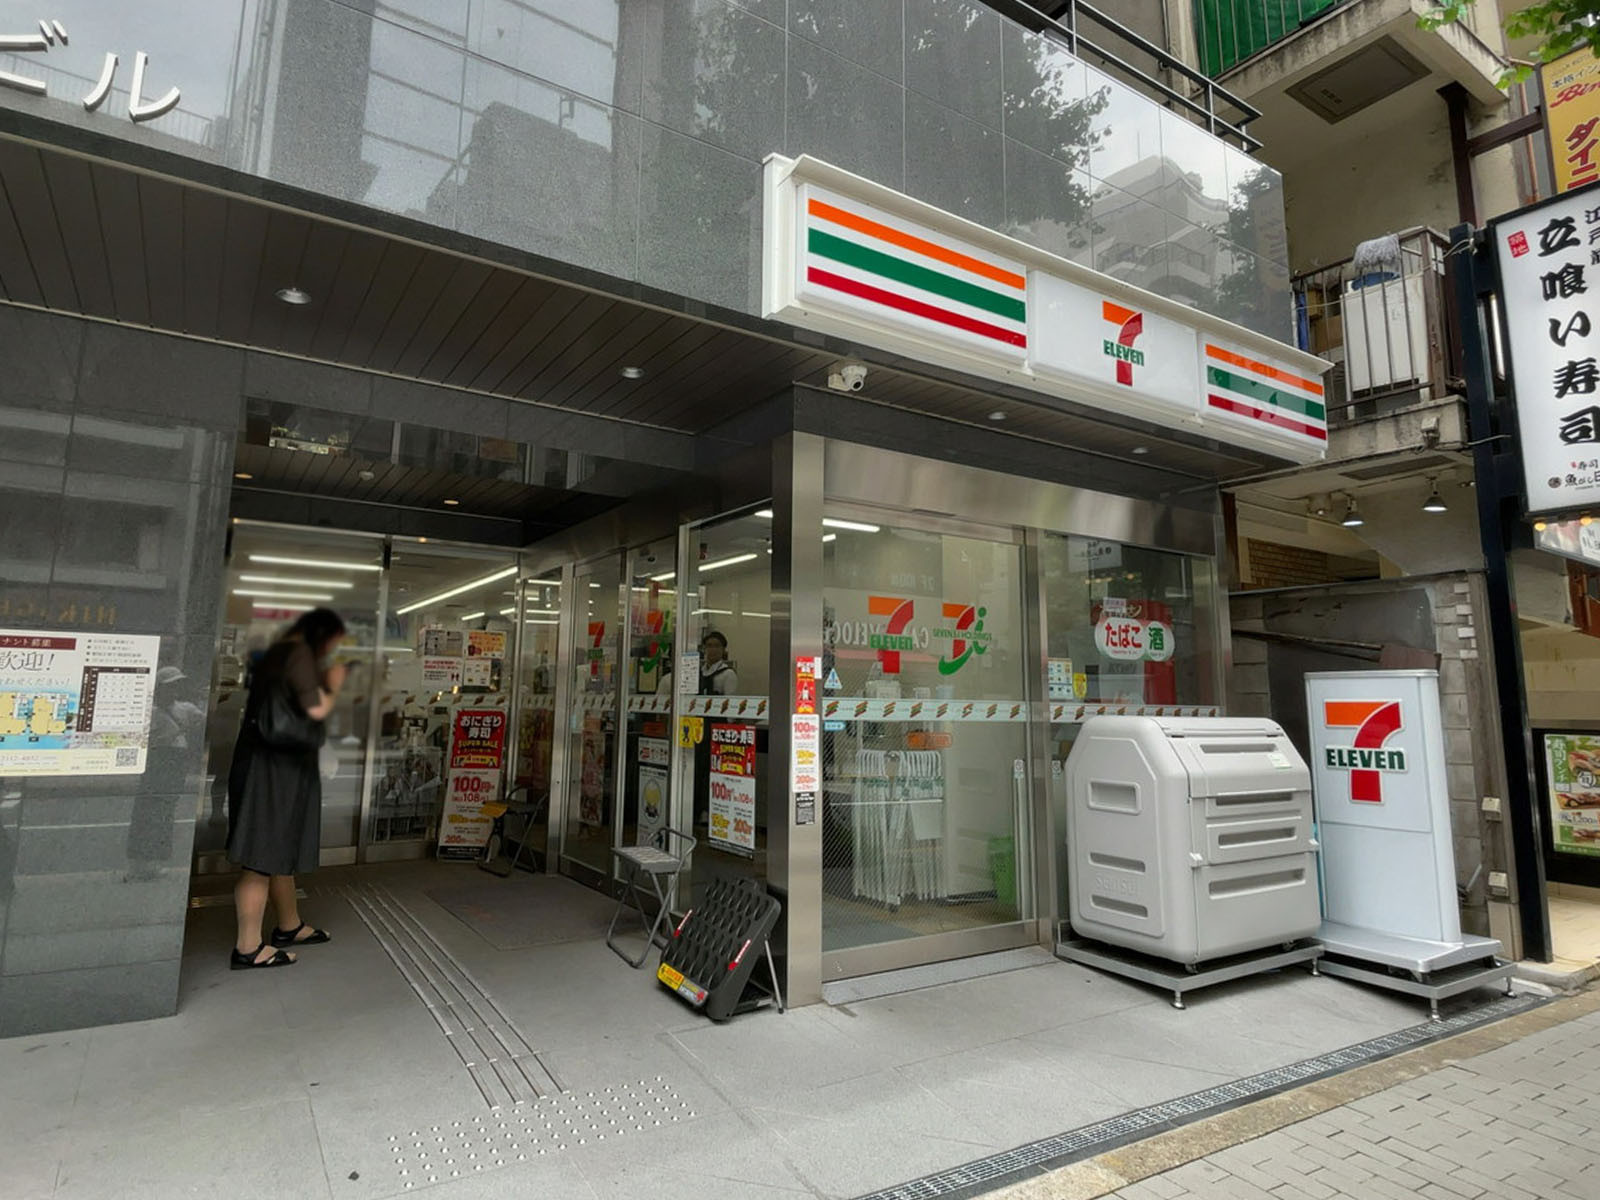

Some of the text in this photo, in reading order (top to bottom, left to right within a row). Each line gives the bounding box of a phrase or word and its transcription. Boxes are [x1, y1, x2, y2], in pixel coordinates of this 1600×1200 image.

[0, 19, 181, 124] ビル
[1105, 623, 1142, 648] たばこ
[1148, 627, 1164, 650] 酒
[460, 715, 502, 727] おにぎり
[468, 727, 492, 739] 寿司
